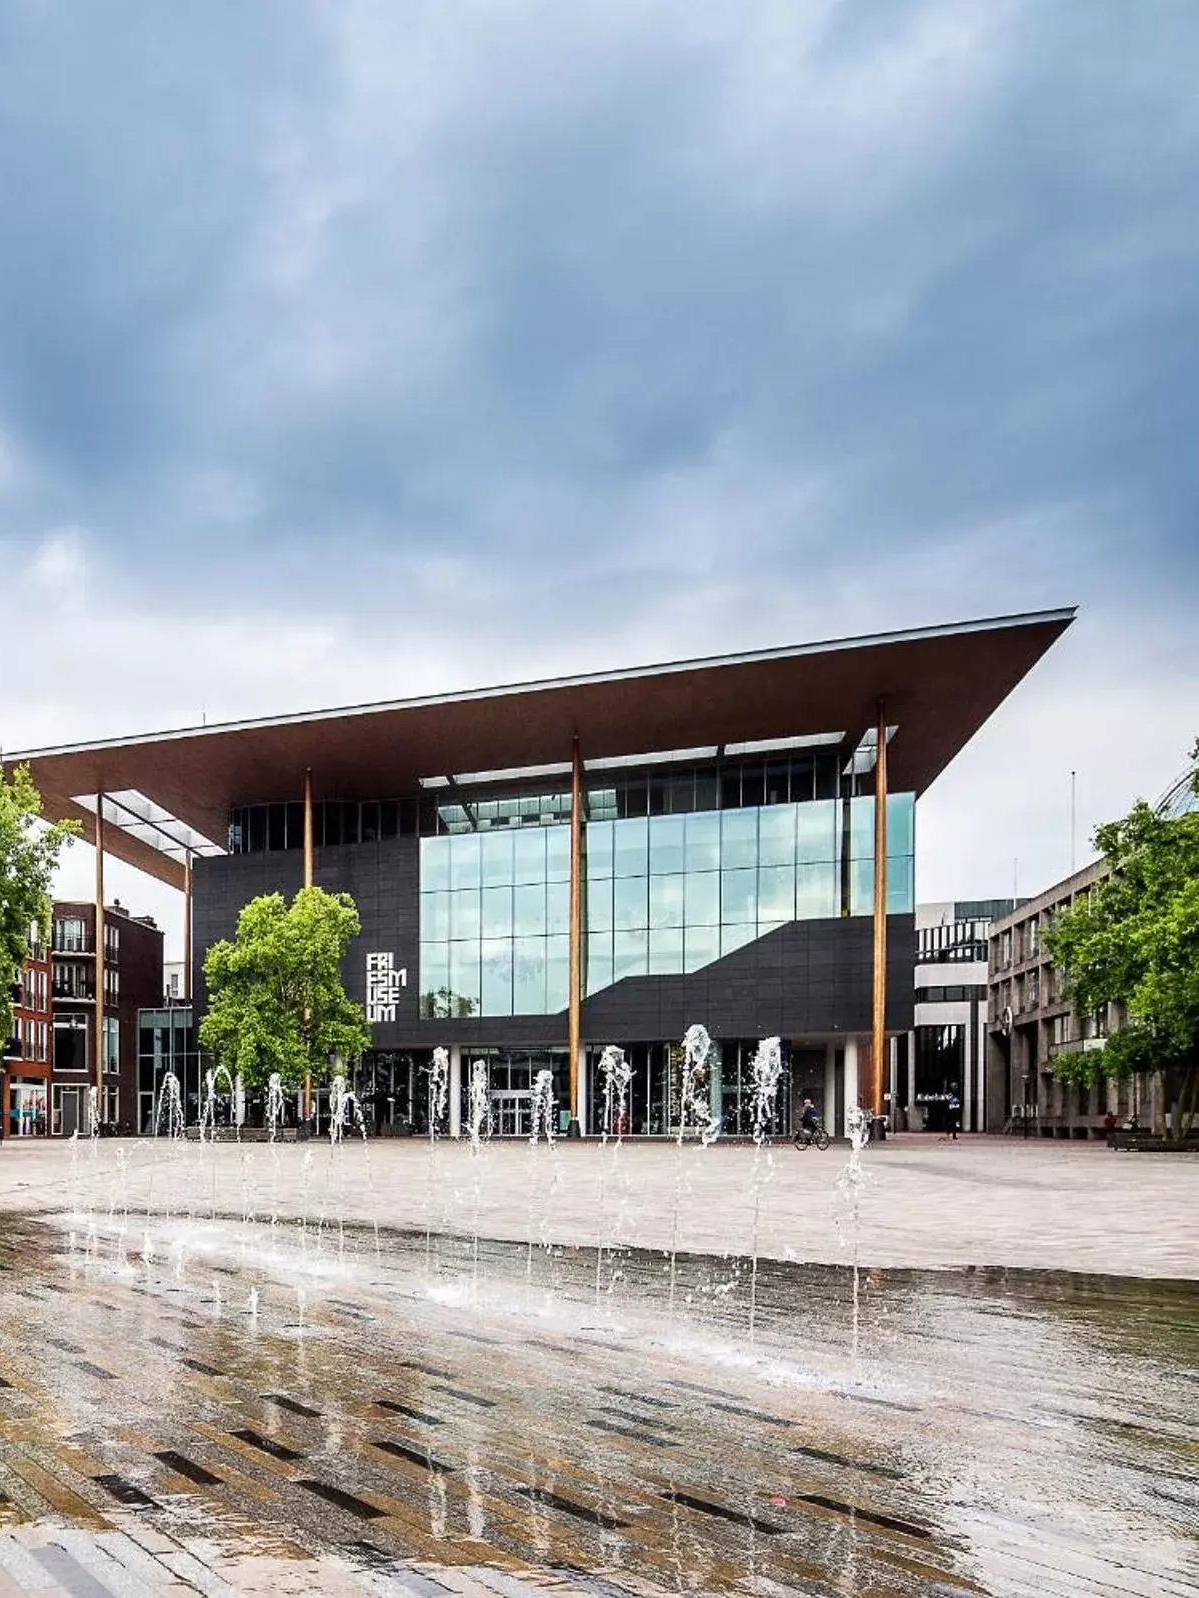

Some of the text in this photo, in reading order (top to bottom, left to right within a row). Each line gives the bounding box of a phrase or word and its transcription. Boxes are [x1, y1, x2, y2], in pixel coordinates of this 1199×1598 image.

[366, 952, 394, 970] FRI
[366, 968, 407, 986] ESM
[366, 987, 399, 1004] USE
[366, 1004, 396, 1022] UM
